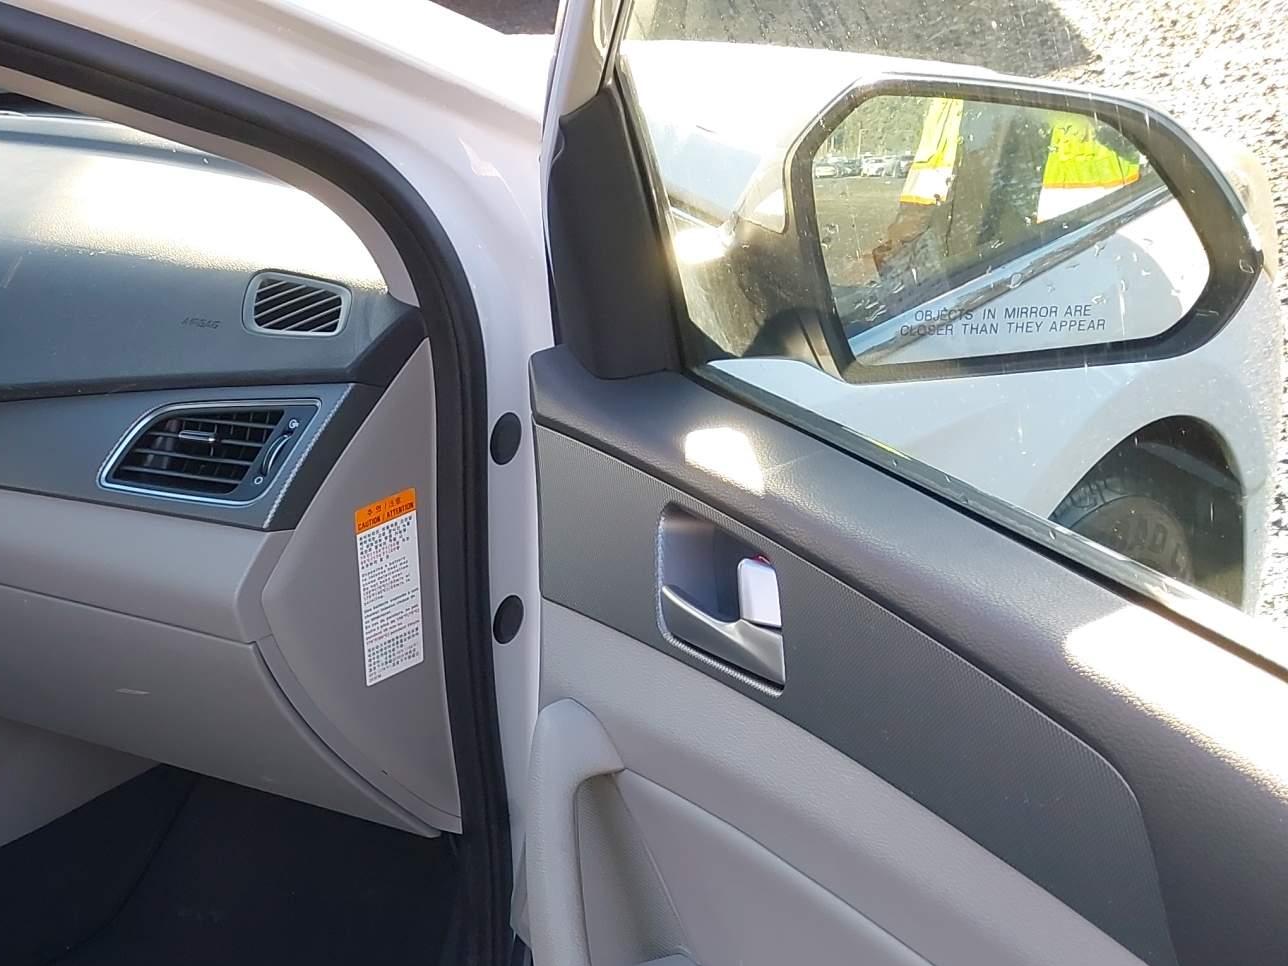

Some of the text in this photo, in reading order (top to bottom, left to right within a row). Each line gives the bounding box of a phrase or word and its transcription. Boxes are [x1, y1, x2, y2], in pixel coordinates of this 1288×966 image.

[914, 304, 1092, 322] OBJECTS IN MIRROR ARE
[900, 319, 1106, 337] CLOSER THAN THEY APPEAR
[357, 515, 381, 532] CAUTION
[386, 501, 414, 518] ATTENTION
